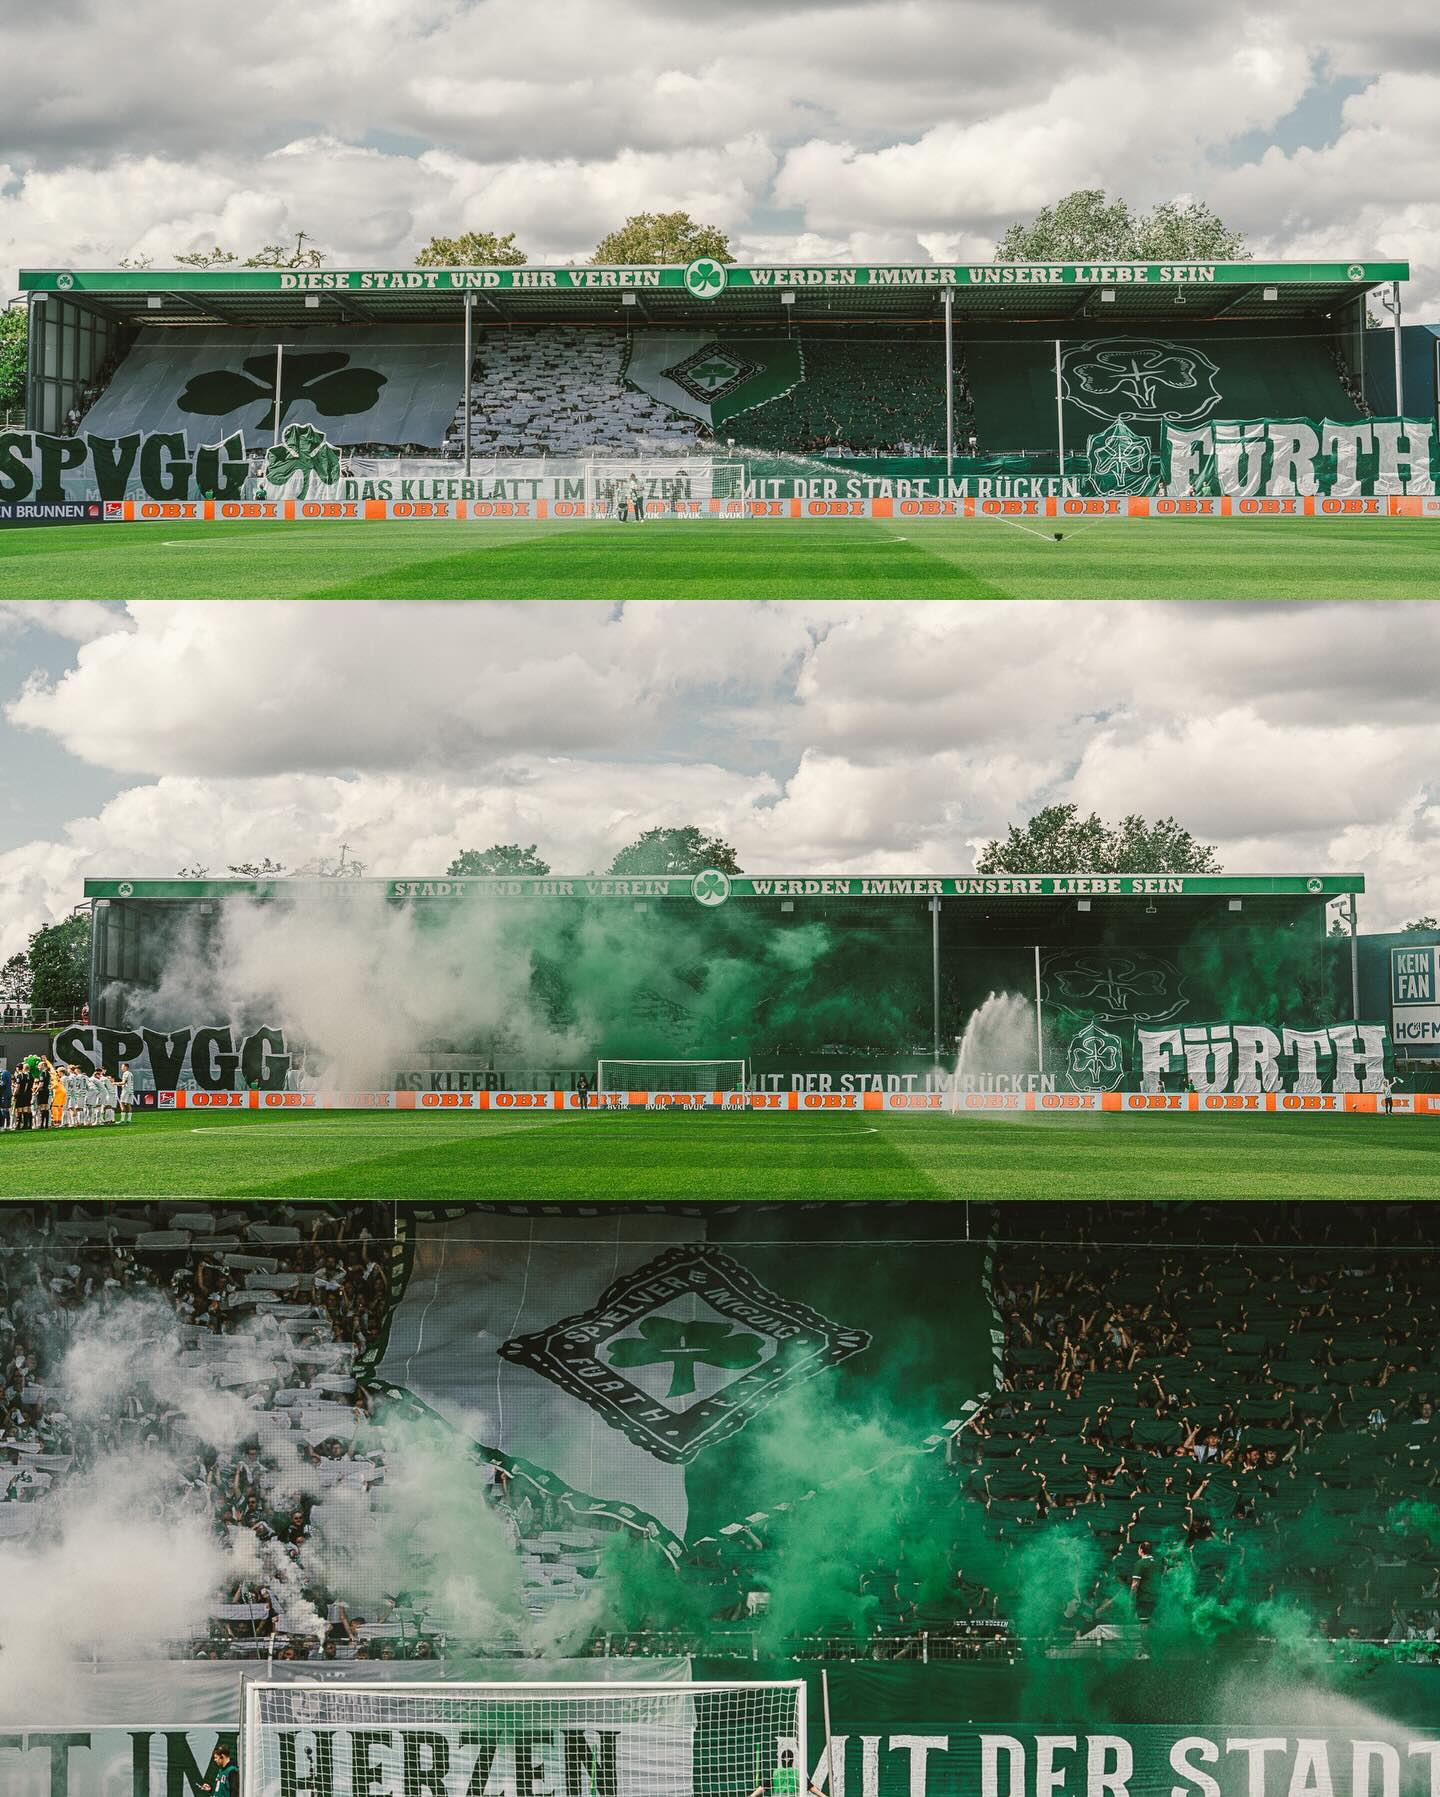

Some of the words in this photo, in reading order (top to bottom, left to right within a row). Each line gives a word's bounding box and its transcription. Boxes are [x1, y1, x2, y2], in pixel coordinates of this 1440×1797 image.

[280, 273, 349, 289] DIESE
[361, 273, 438, 289] STADT
[450, 272, 500, 288] UND
[512, 272, 557, 287] IHR
[569, 271, 661, 287] VEREIN
[750, 270, 856, 285] WERDEN
[868, 269, 957, 284] IMMER
[968, 268, 1063, 283] UNSERE
[1075, 267, 1149, 283] LIEBE
[1159, 267, 1216, 282] SEIN
[1166, 422, 1436, 496] FÜRTH
[0, 433, 250, 501] SPVGG
[345, 479, 393, 500] DAS
[401, 478, 544, 500] KLEEBLATT
[554, 478, 585, 499] IM
[793, 478, 838, 499] DER
[846, 477, 930, 498] STADT
[938, 477, 968, 498] IM
[978, 476, 1079, 497] RÜCKEN
[16, 504, 84, 518] BRUNNEN
[141, 503, 196, 517] OBI
[222, 503, 277, 517] OBI
[302, 503, 357, 517] OBI
[393, 502, 448, 517] OBI
[474, 502, 529, 516] OBI
[727, 501, 782, 515] OBI
[808, 501, 863, 515] OBI
[901, 501, 956, 515] OBI
[982, 500, 1038, 514] OBI
[1064, 500, 1119, 514] OBI
[1156, 500, 1213, 514] OBI
[1239, 499, 1296, 514] OBI
[1322, 499, 1379, 513] OBI
[394, 882, 465, 896] STADT
[532, 881, 575, 896] IHR
[585, 881, 670, 896] VEREIN
[752, 880, 850, 894] WERDEN
[861, 880, 943, 894] IMMER
[954, 879, 1043, 894] UNSERE
[1053, 879, 1121, 894] LIEBE
[1132, 879, 1184, 893] SEIN
[1397, 954, 1429, 973] KEIN
[1398, 975, 1430, 999] FAN
[55, 1025, 291, 1091] SPVGG
[1138, 1025, 1387, 1093] FÜRTH
[791, 1074, 832, 1092] DER
[840, 1073, 918, 1092] STADT
[966, 1073, 1055, 1092] RÜCKEN
[192, 1093, 242, 1106] OBI
[265, 1093, 316, 1107] OBI
[422, 1093, 473, 1107] OBI
[496, 1093, 547, 1107] OBI
[730, 1094, 781, 1107] OBI
[804, 1094, 856, 1108] OBI
[889, 1094, 942, 1108] OBI
[965, 1095, 1018, 1108] OBI
[1041, 1095, 1095, 1108] OBI
[1128, 1095, 1182, 1109] OBI
[1205, 1095, 1259, 1109] OBI
[1283, 1095, 1337, 1109] OBI
[128, 1732, 240, 1797] IM
[275, 1730, 622, 1797] HERZEN
[979, 1735, 1133, 1797] DER
